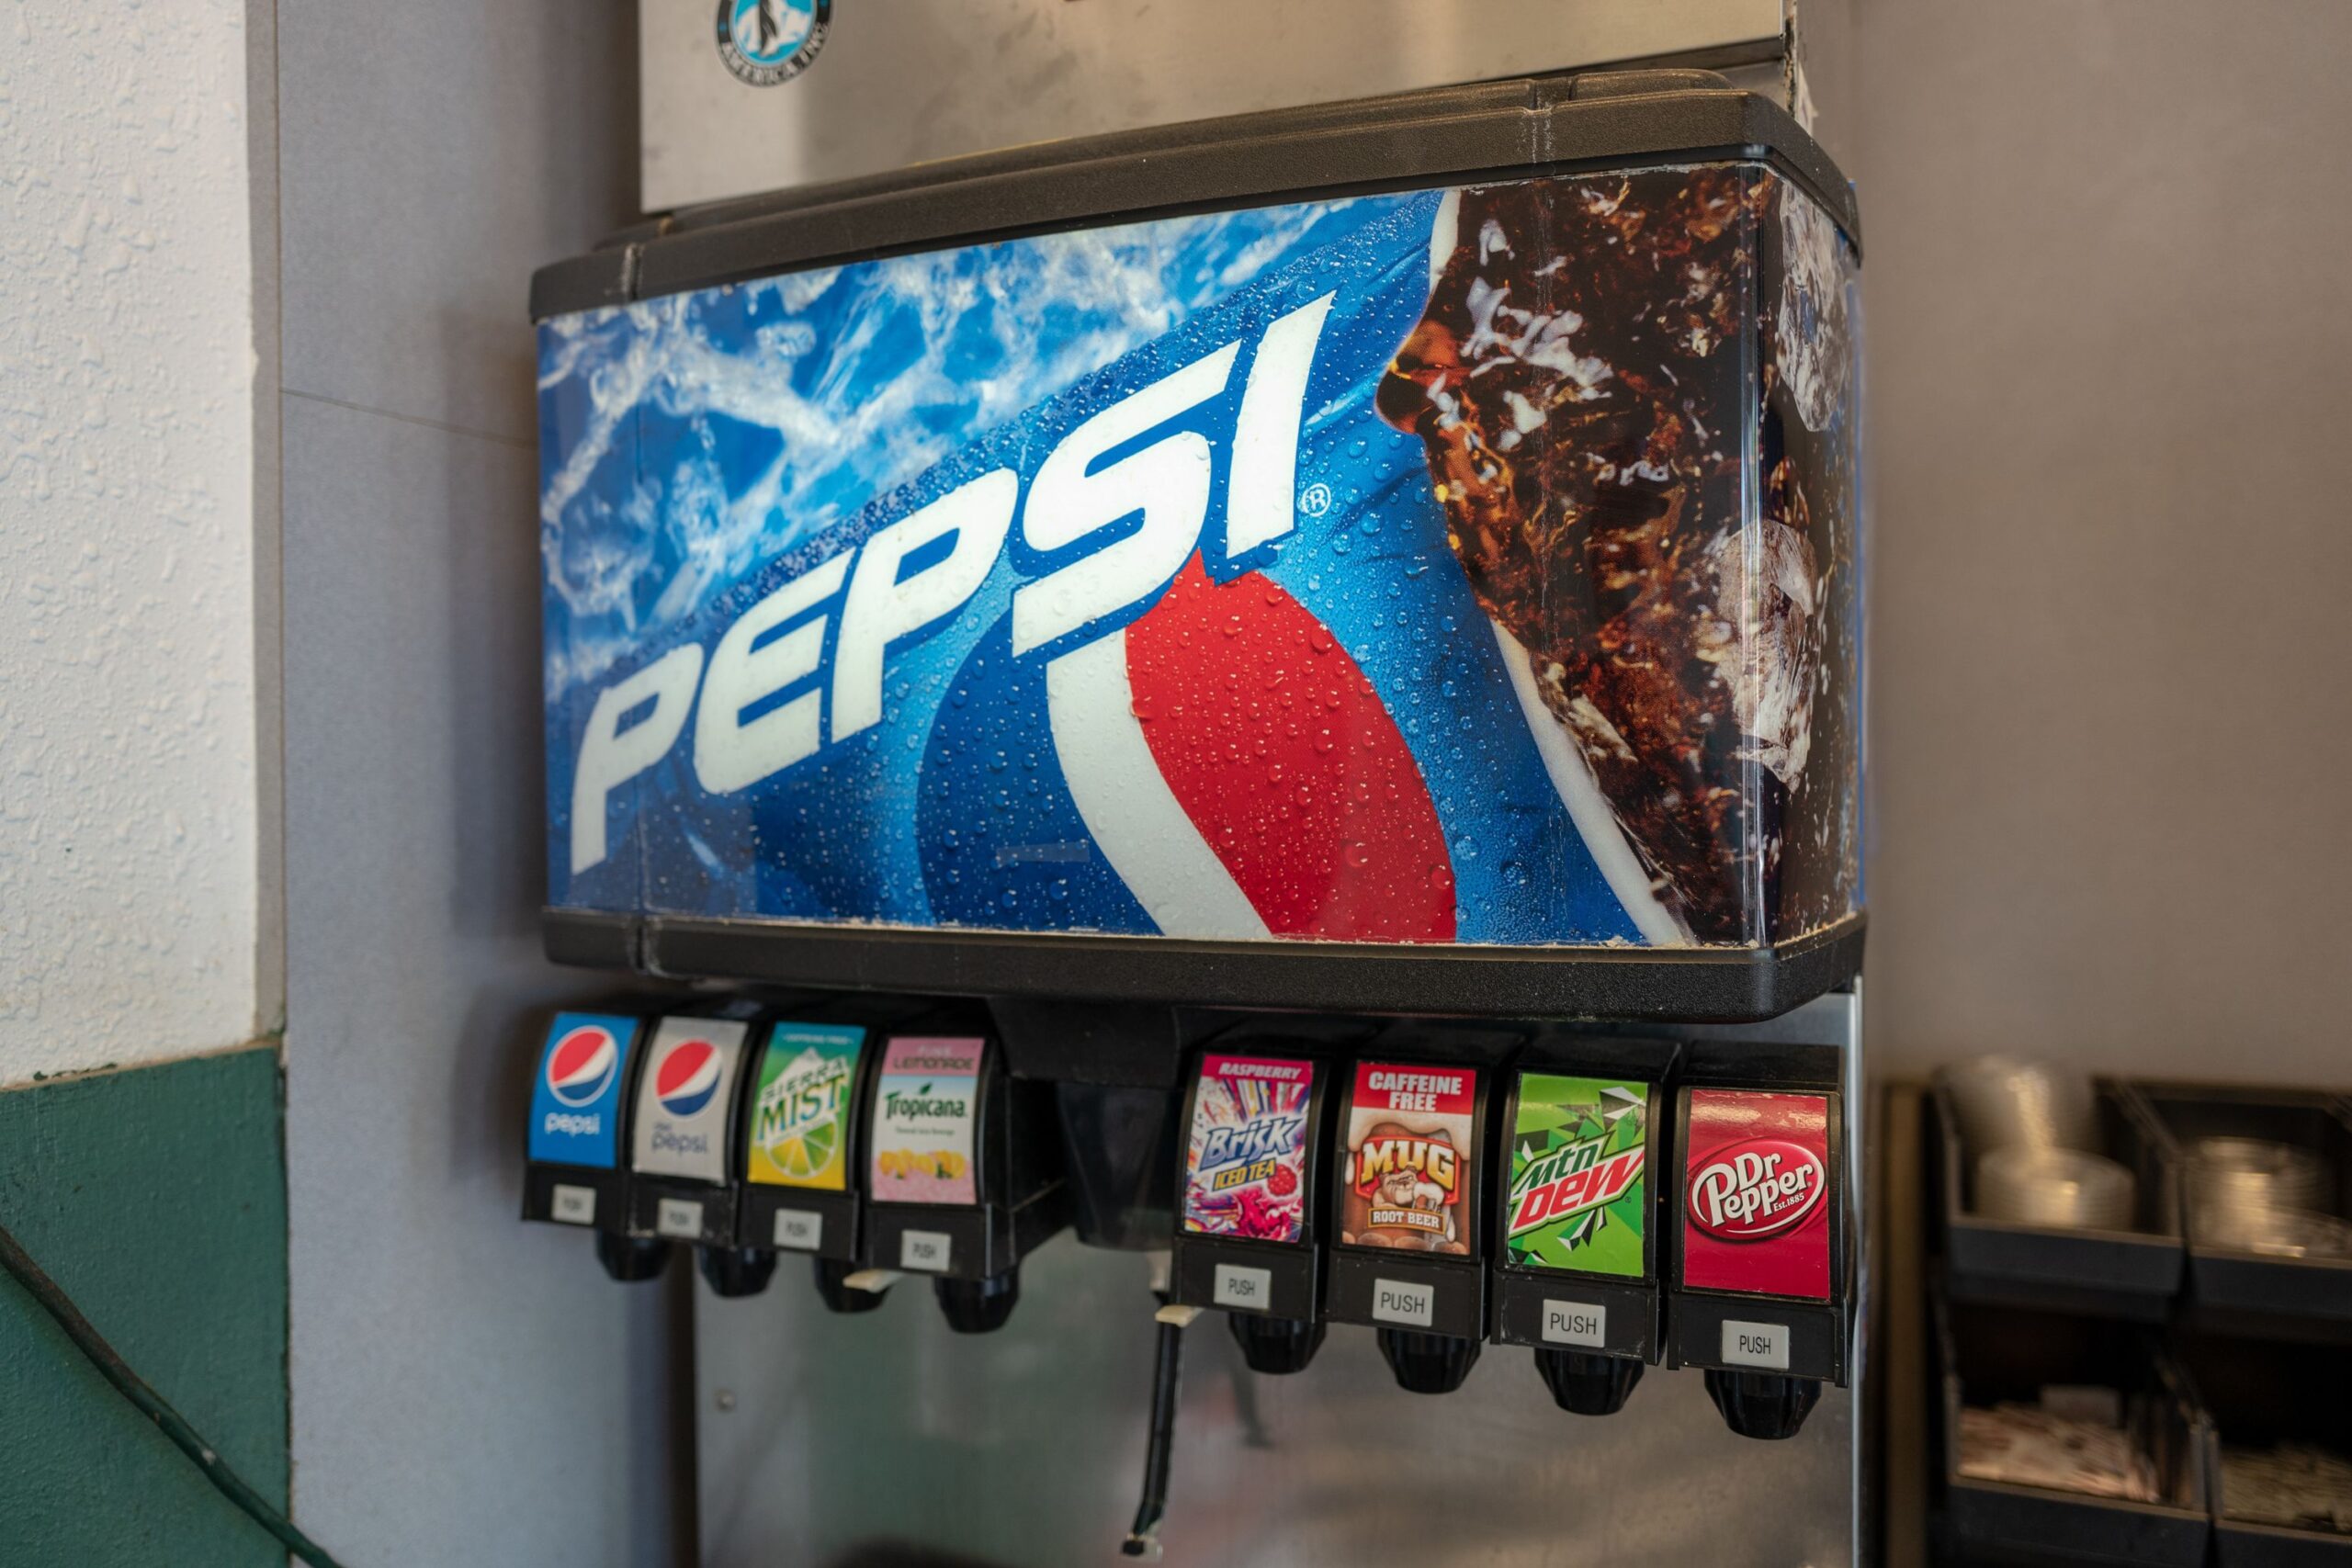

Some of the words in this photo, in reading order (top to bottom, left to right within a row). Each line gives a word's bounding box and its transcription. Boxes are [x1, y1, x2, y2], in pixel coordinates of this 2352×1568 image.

[571, 289, 1337, 876] PEPSI
[763, 1056, 844, 1099] SIERRA
[1218, 1062, 1303, 1080] RASPBERRY
[1368, 1071, 1463, 1096] CAFFEINE
[757, 1073, 845, 1141] MIST
[884, 1083, 966, 1121] Tropicana
[1388, 1092, 1437, 1112] FREE
[545, 1112, 601, 1136] pepsi
[651, 1132, 707, 1156] pepsi
[1215, 1168, 1248, 1190] ICED
[1249, 1159, 1276, 1182] TEA
[1361, 1140, 1456, 1191] MUG
[1734, 1152, 1781, 1190] Dr
[1692, 1163, 1814, 1227] Pepper
[1373, 1210, 1405, 1224] ROOT
[1408, 1212, 1440, 1228] BEER
[1228, 1278, 1256, 1296] PUSH
[1380, 1292, 1425, 1314] PUSH
[1550, 1313, 1598, 1335] PUSH
[1739, 1335, 1771, 1355] PUSH
